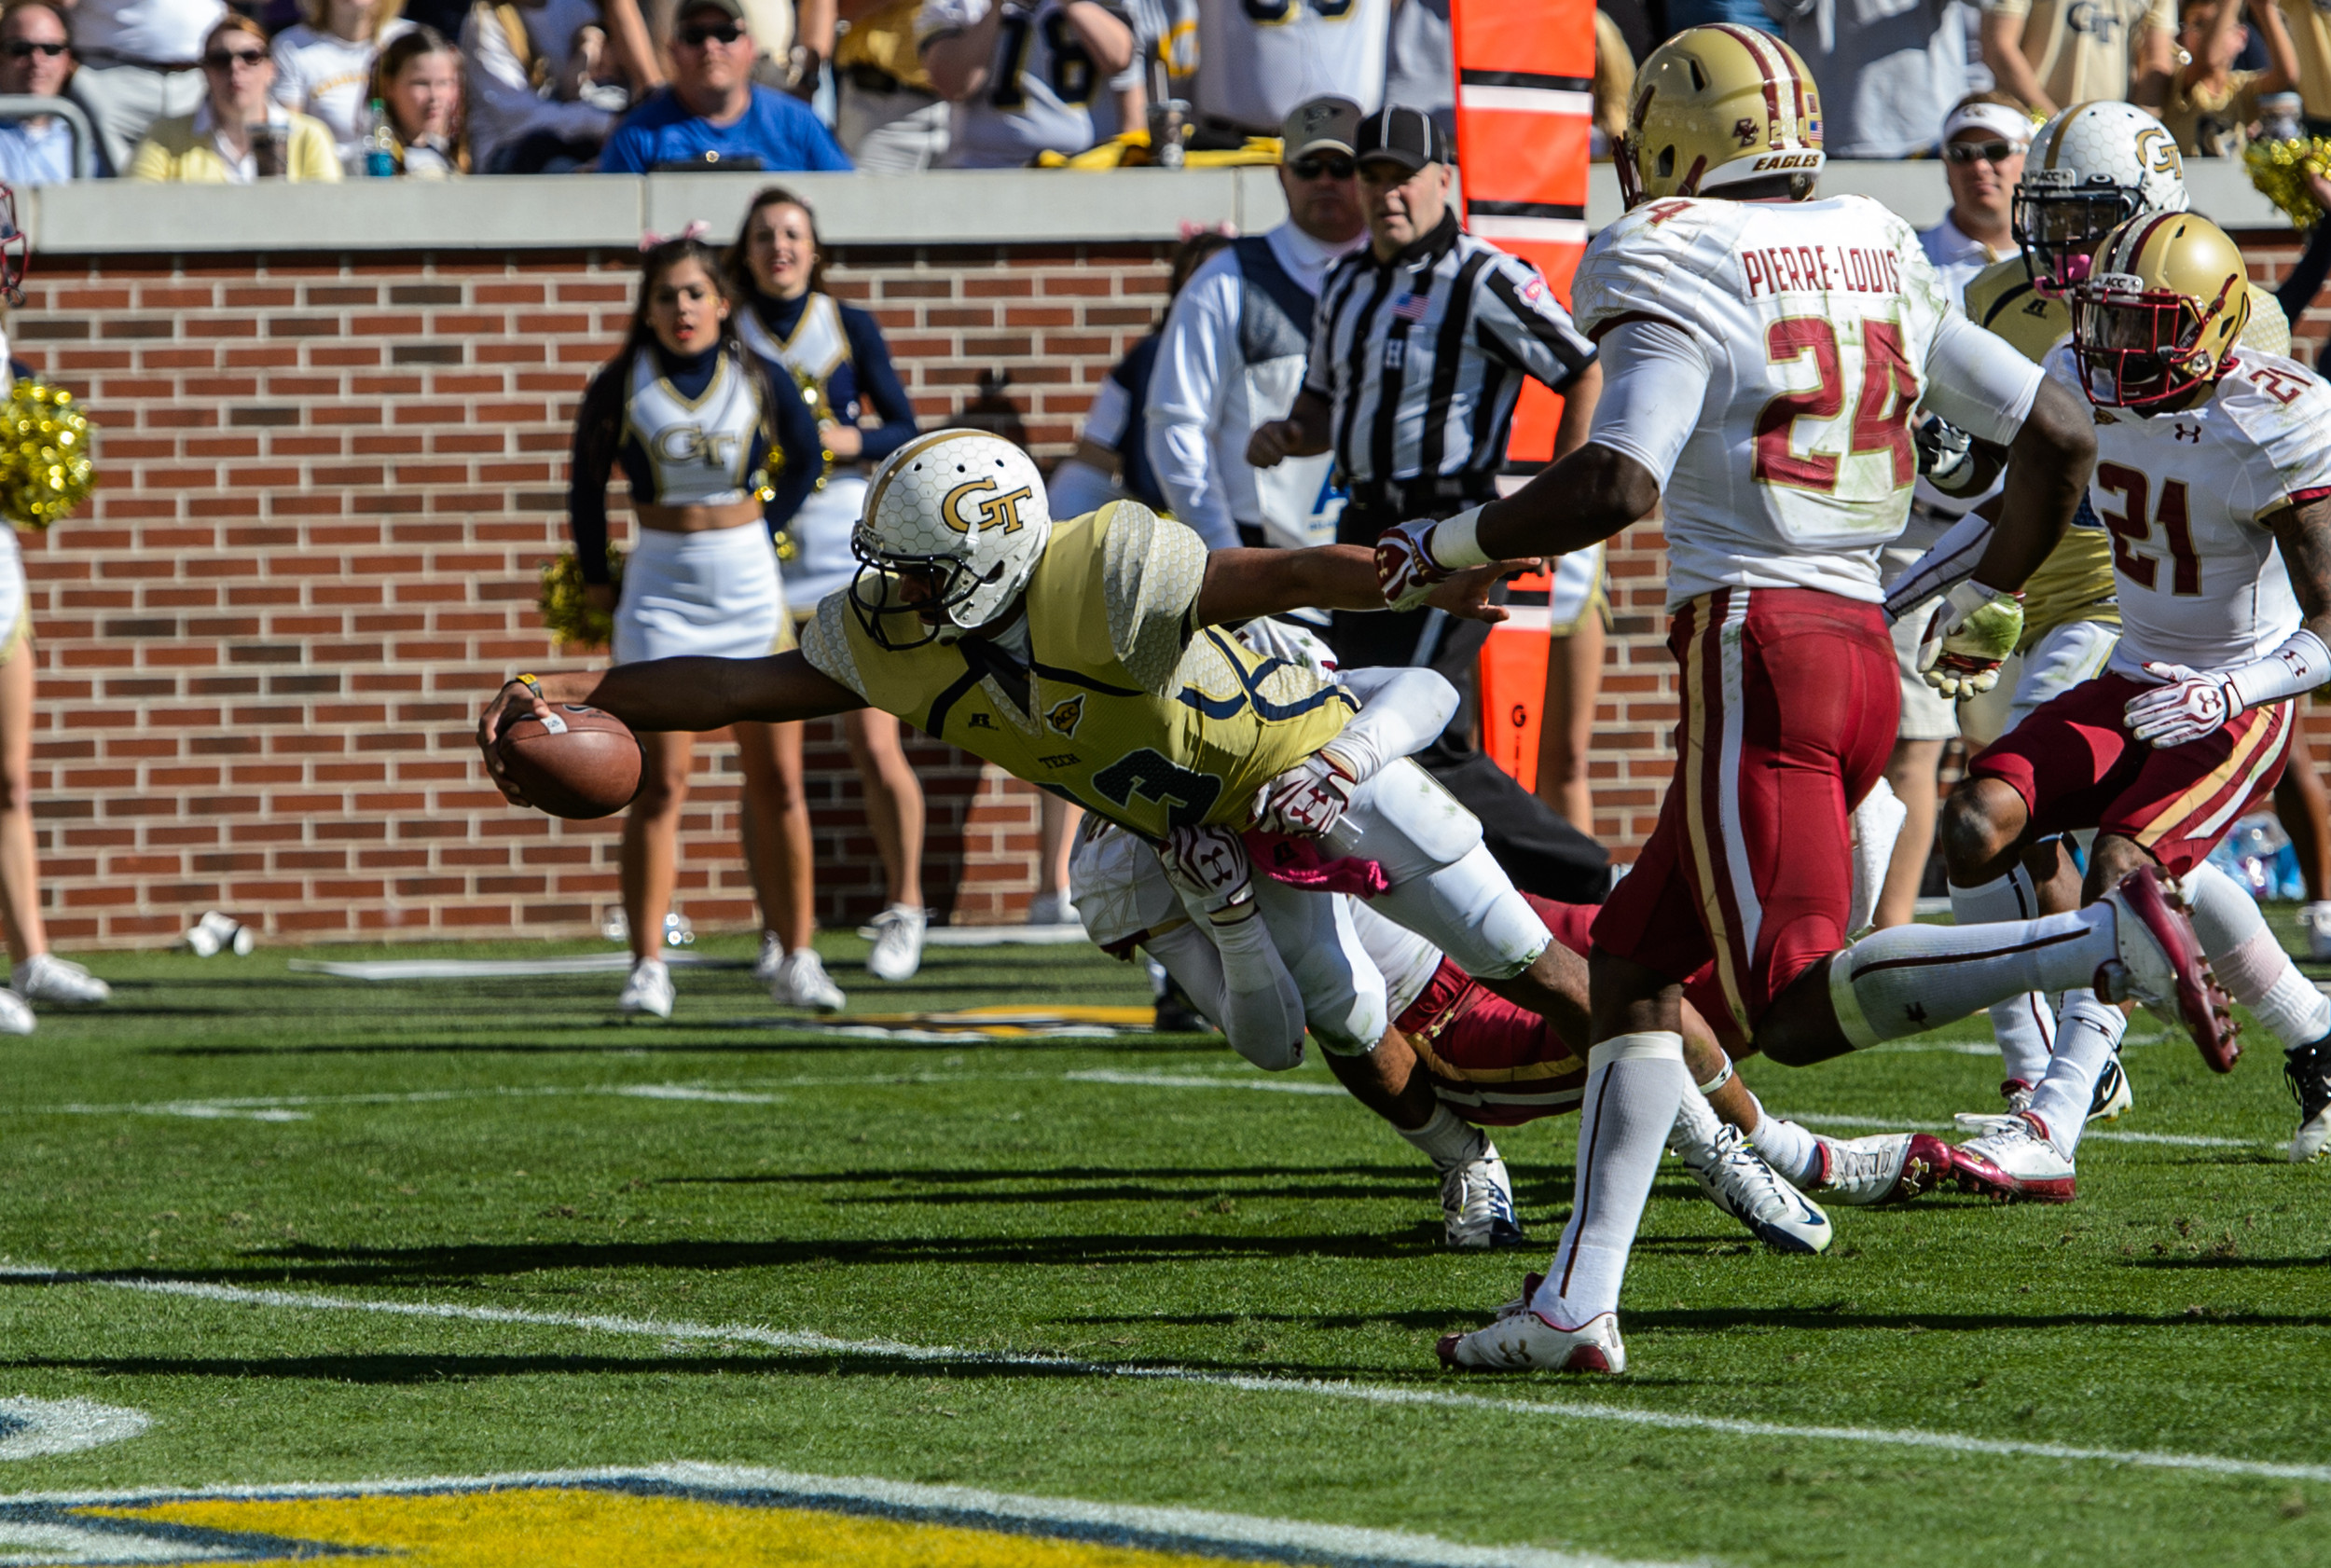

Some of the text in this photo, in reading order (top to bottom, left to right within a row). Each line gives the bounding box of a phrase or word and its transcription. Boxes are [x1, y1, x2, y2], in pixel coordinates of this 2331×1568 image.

[1752, 154, 1819, 172] EAGLES
[2133, 127, 2184, 181] GT
[1741, 244, 1901, 298] PIERRE-LOUIS
[2103, 275, 2127, 289] ACC
[1751, 314, 1920, 496] 24
[2249, 366, 2312, 406] 21
[652, 421, 736, 469] GT
[941, 475, 1033, 536] GT
[2097, 460, 2202, 597] 21
[1052, 705, 1078, 731] ACC
[1037, 752, 1083, 770] TECH
